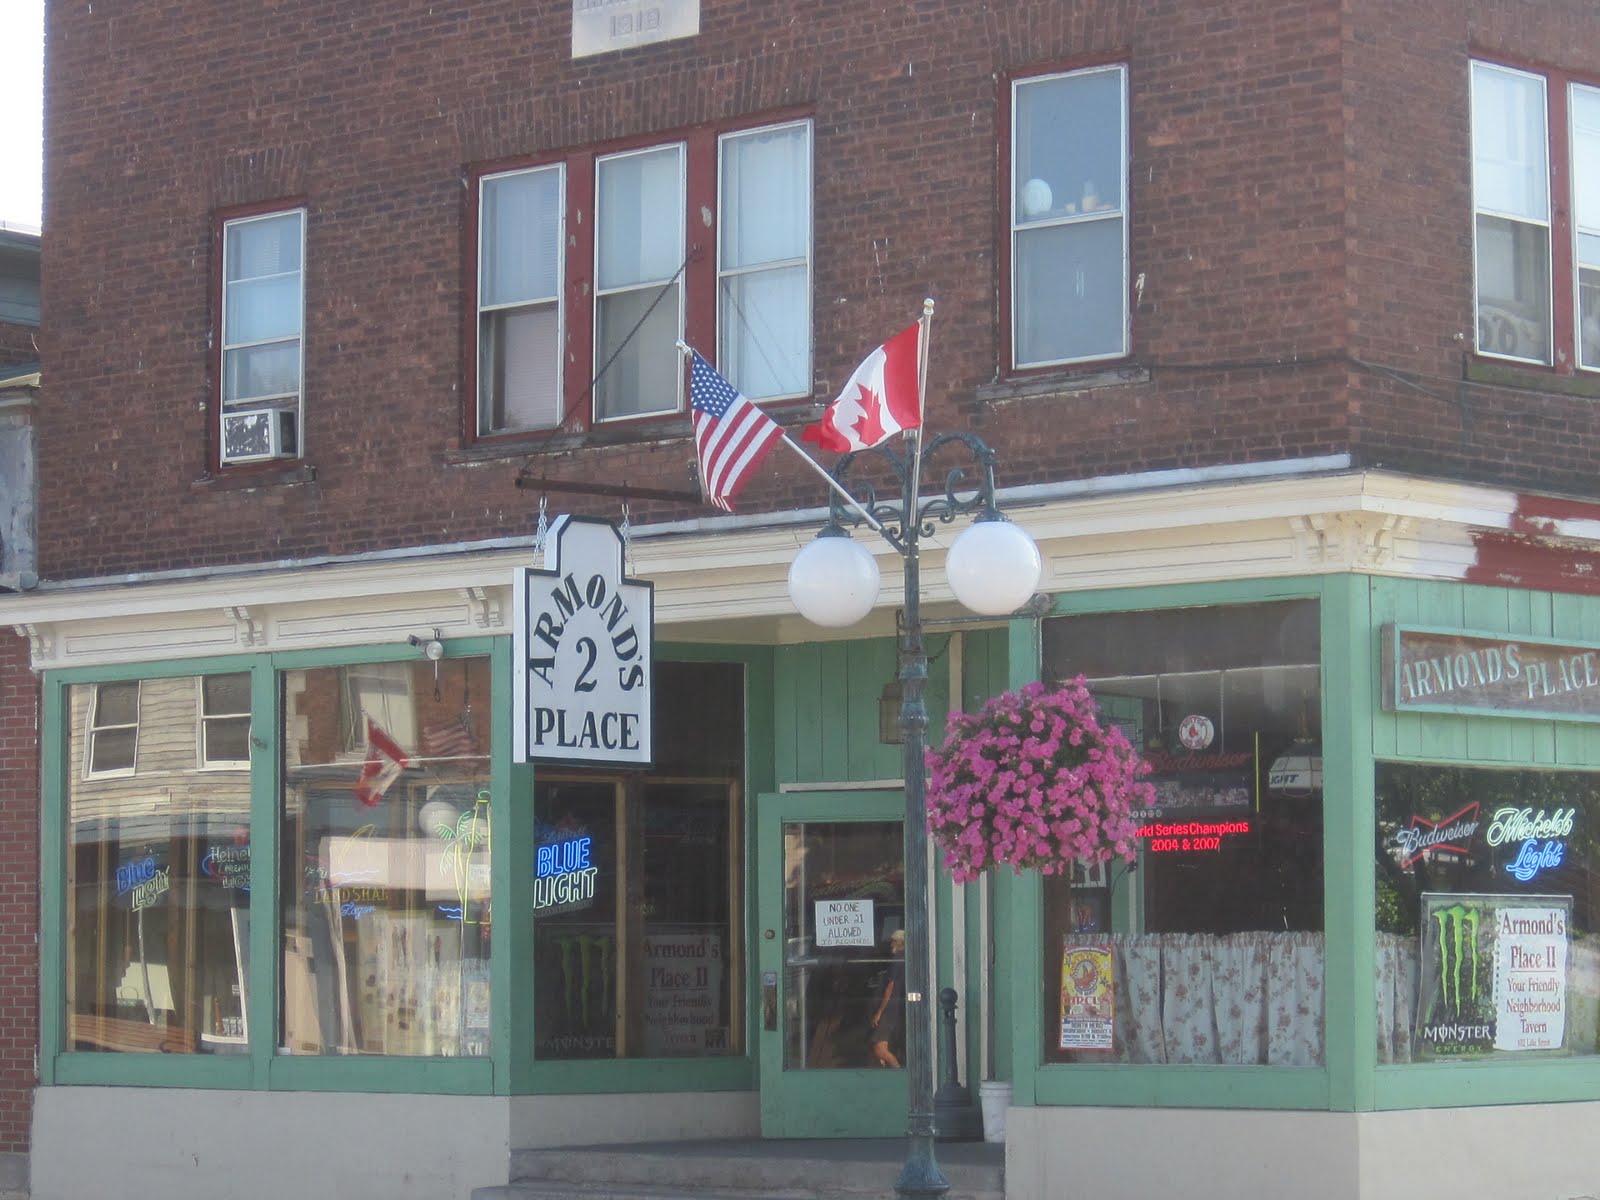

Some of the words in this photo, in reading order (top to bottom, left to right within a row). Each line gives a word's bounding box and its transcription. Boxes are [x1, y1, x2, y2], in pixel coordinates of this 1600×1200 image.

[529, 573, 643, 692] ARMOND'S
[574, 636, 597, 692] 2
[1525, 652, 1598, 699] PLACE
[534, 707, 640, 750] PLACE
[1156, 823, 1188, 836] Series
[1189, 821, 1249, 836] Champions
[1396, 821, 1479, 855] Budweiser
[1487, 807, 1575, 847] Michelob
[1151, 839, 1179, 851] 2004
[1182, 838, 1190, 850] &
[1193, 837, 1220, 850] 2007
[537, 837, 591, 877] BLUE
[1505, 839, 1563, 881] Light
[116, 857, 154, 896] Blue
[533, 867, 598, 909] LIGHT
[829, 903, 842, 913] NO
[844, 902, 860, 912] ONE
[823, 915, 850, 926] UNDER
[853, 914, 864, 924] 21
[1501, 912, 1564, 936] Armond's
[828, 927, 862, 938] ALLOWED
[1511, 946, 1542, 968] Place
[1546, 946, 1556, 968] II
[1508, 978, 1526, 992] Your
[1529, 977, 1560, 996] Friendly
[1506, 997, 1561, 1017] Neighborhood
[1424, 1023, 1492, 1043] MONSTER
[1521, 1019, 1547, 1034] Tavern
[1435, 1044, 1482, 1053] ENERGY
